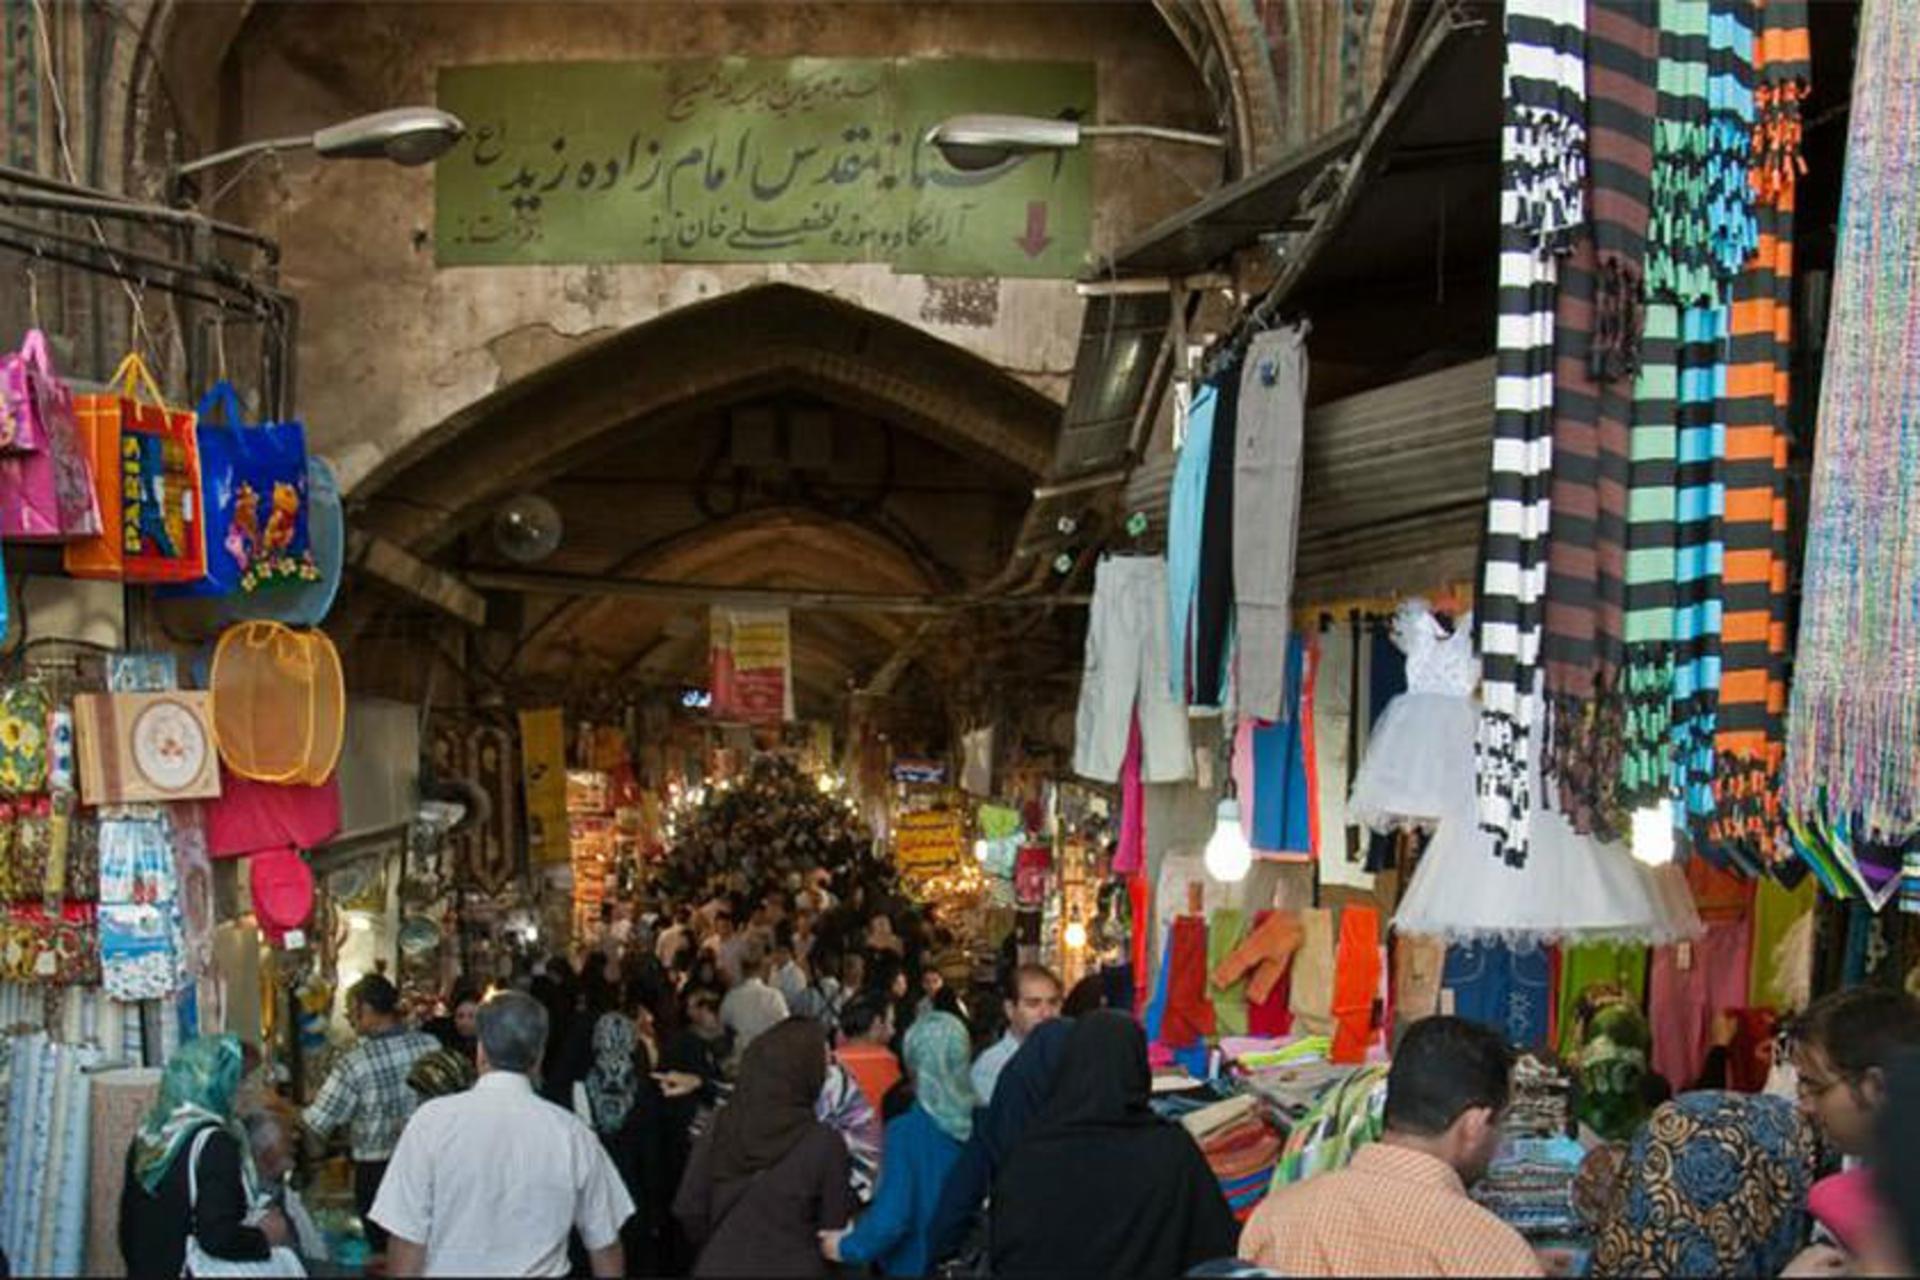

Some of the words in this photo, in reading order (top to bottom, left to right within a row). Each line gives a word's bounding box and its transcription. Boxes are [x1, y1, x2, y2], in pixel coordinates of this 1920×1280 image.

[498, 136, 569, 211] زید
[577, 131, 661, 192] زاده
[667, 127, 752, 212] امام
[752, 125, 881, 201] مقدس
[876, 107, 1086, 188] آسانه
